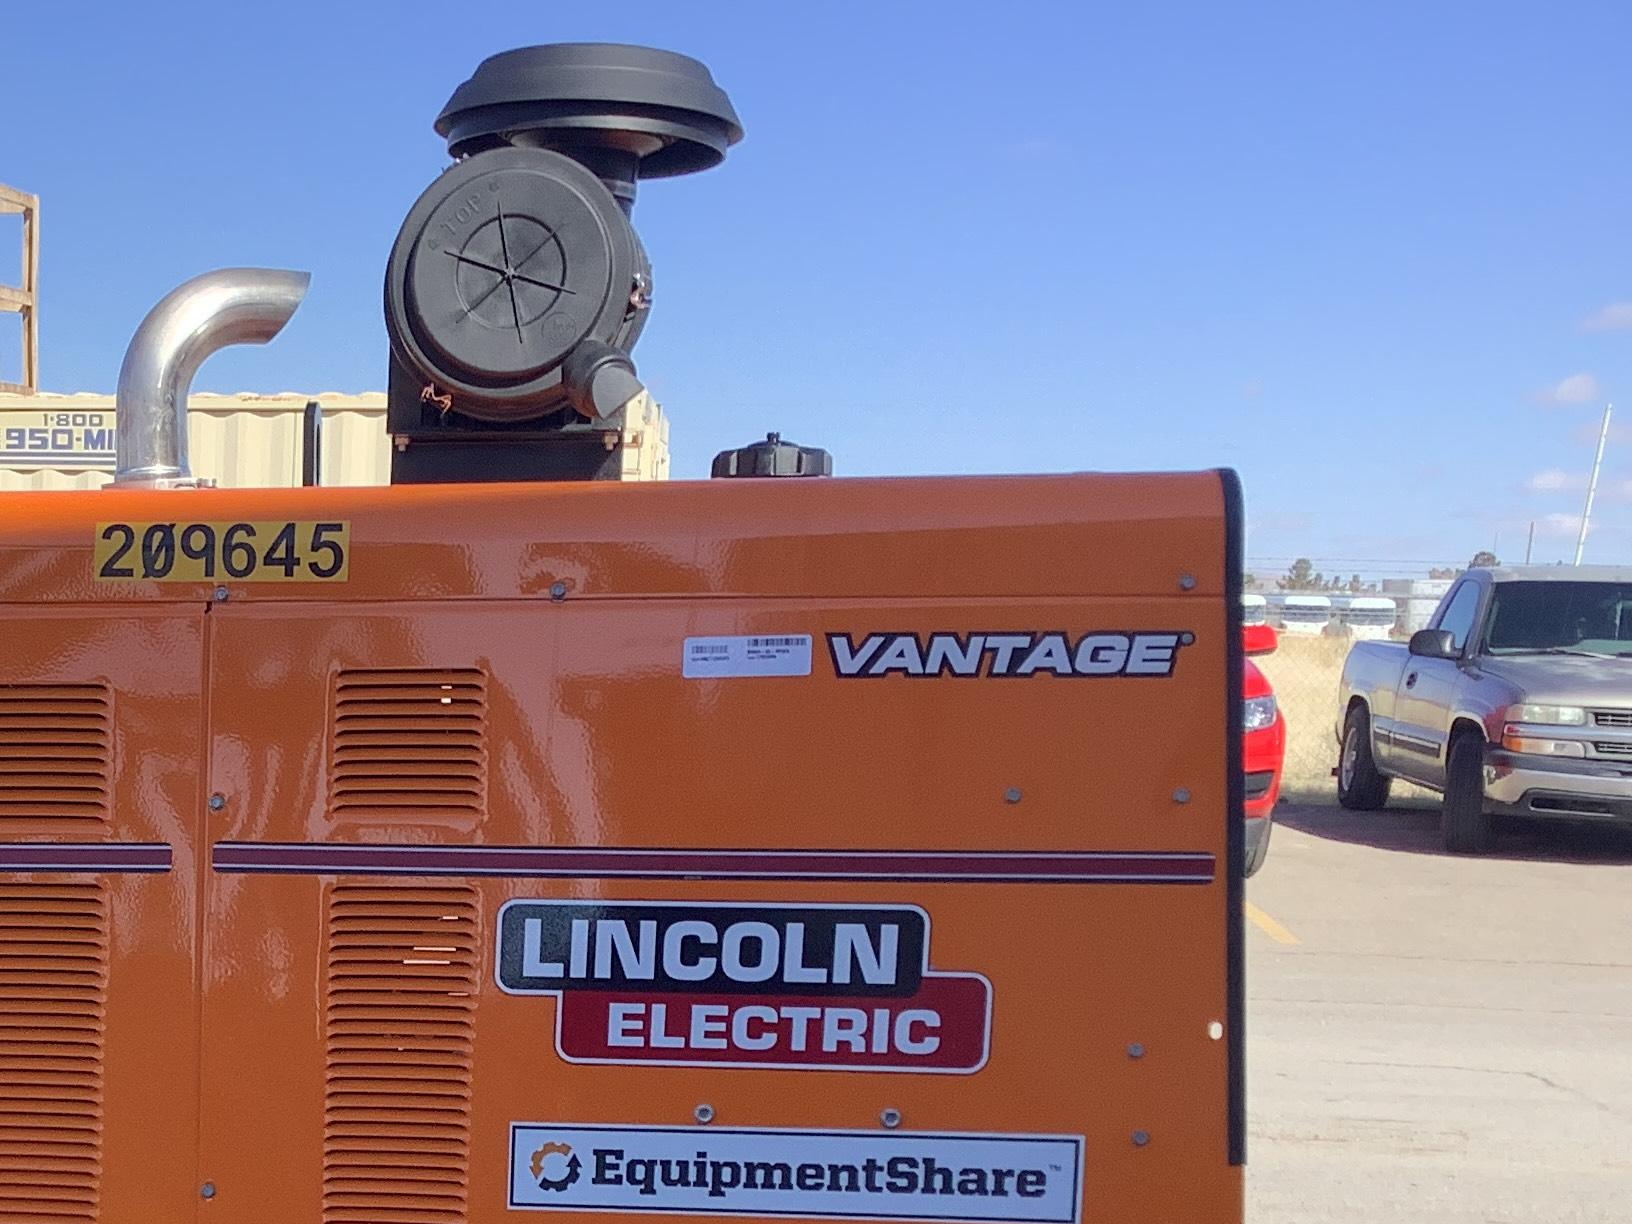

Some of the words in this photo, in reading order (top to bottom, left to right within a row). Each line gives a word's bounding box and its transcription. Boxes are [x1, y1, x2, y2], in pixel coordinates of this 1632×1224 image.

[5, 428, 116, 450] 950-MI
[99, 522, 345, 579] 209645
[828, 633, 1180, 677] VANTAGE
[521, 917, 900, 986] LINCOLN
[606, 1002, 942, 1056] ELECTRIC
[591, 1148, 1048, 1198] EquipmentShare
